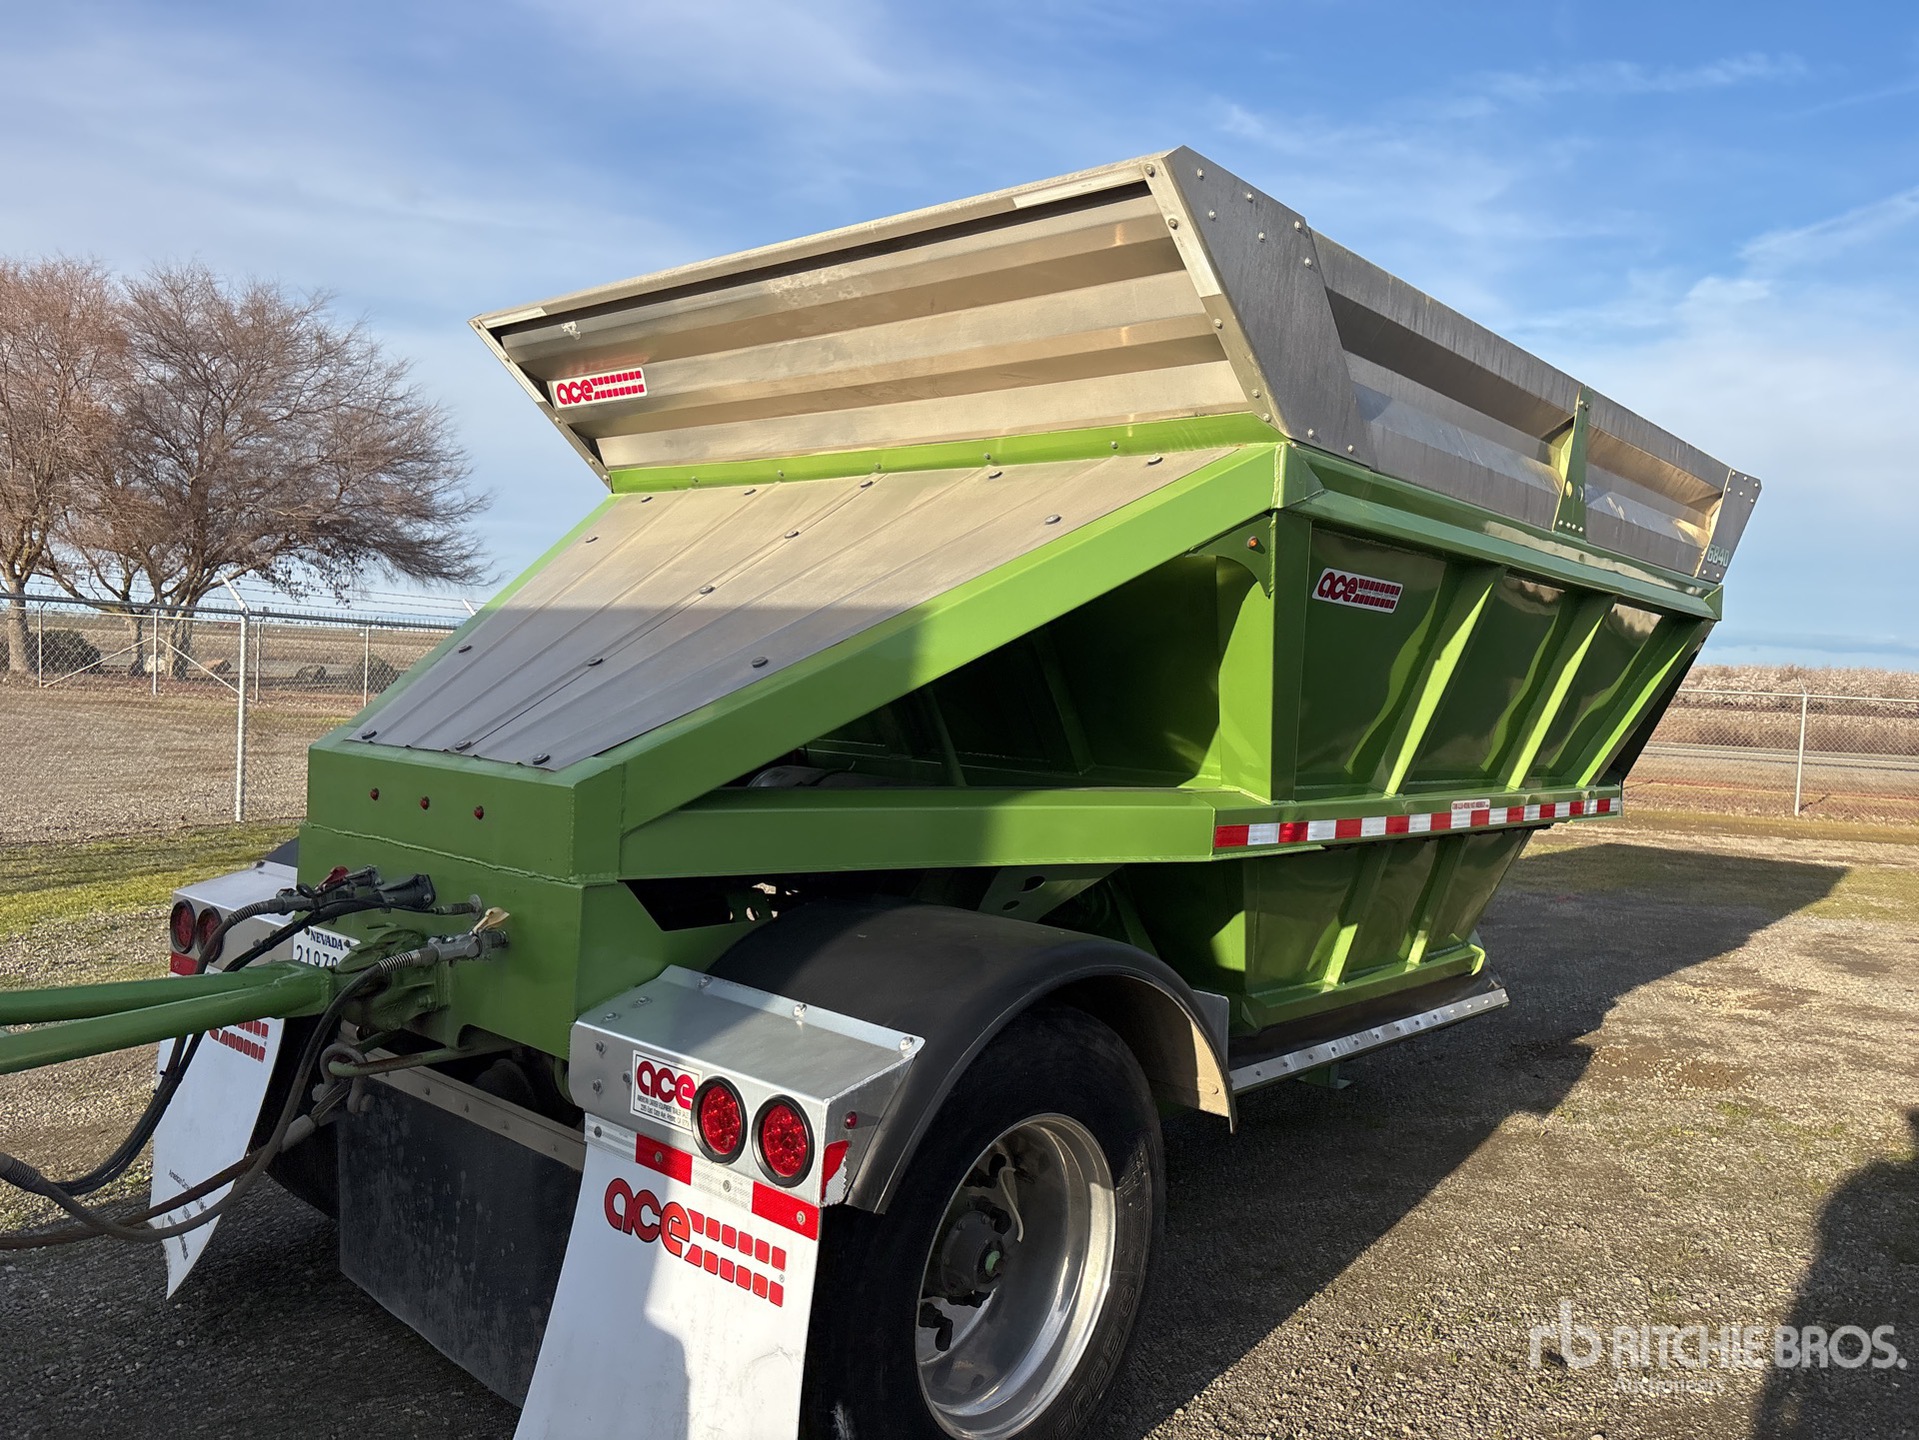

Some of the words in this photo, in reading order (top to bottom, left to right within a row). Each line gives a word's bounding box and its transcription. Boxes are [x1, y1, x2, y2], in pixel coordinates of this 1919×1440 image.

[556, 379, 594, 405] ace
[1706, 543, 1730, 567] 6840
[1317, 571, 1358, 602] ace
[310, 930, 343, 951] NEVADA
[636, 1060, 697, 1110] ace
[604, 1177, 691, 1258] ace
